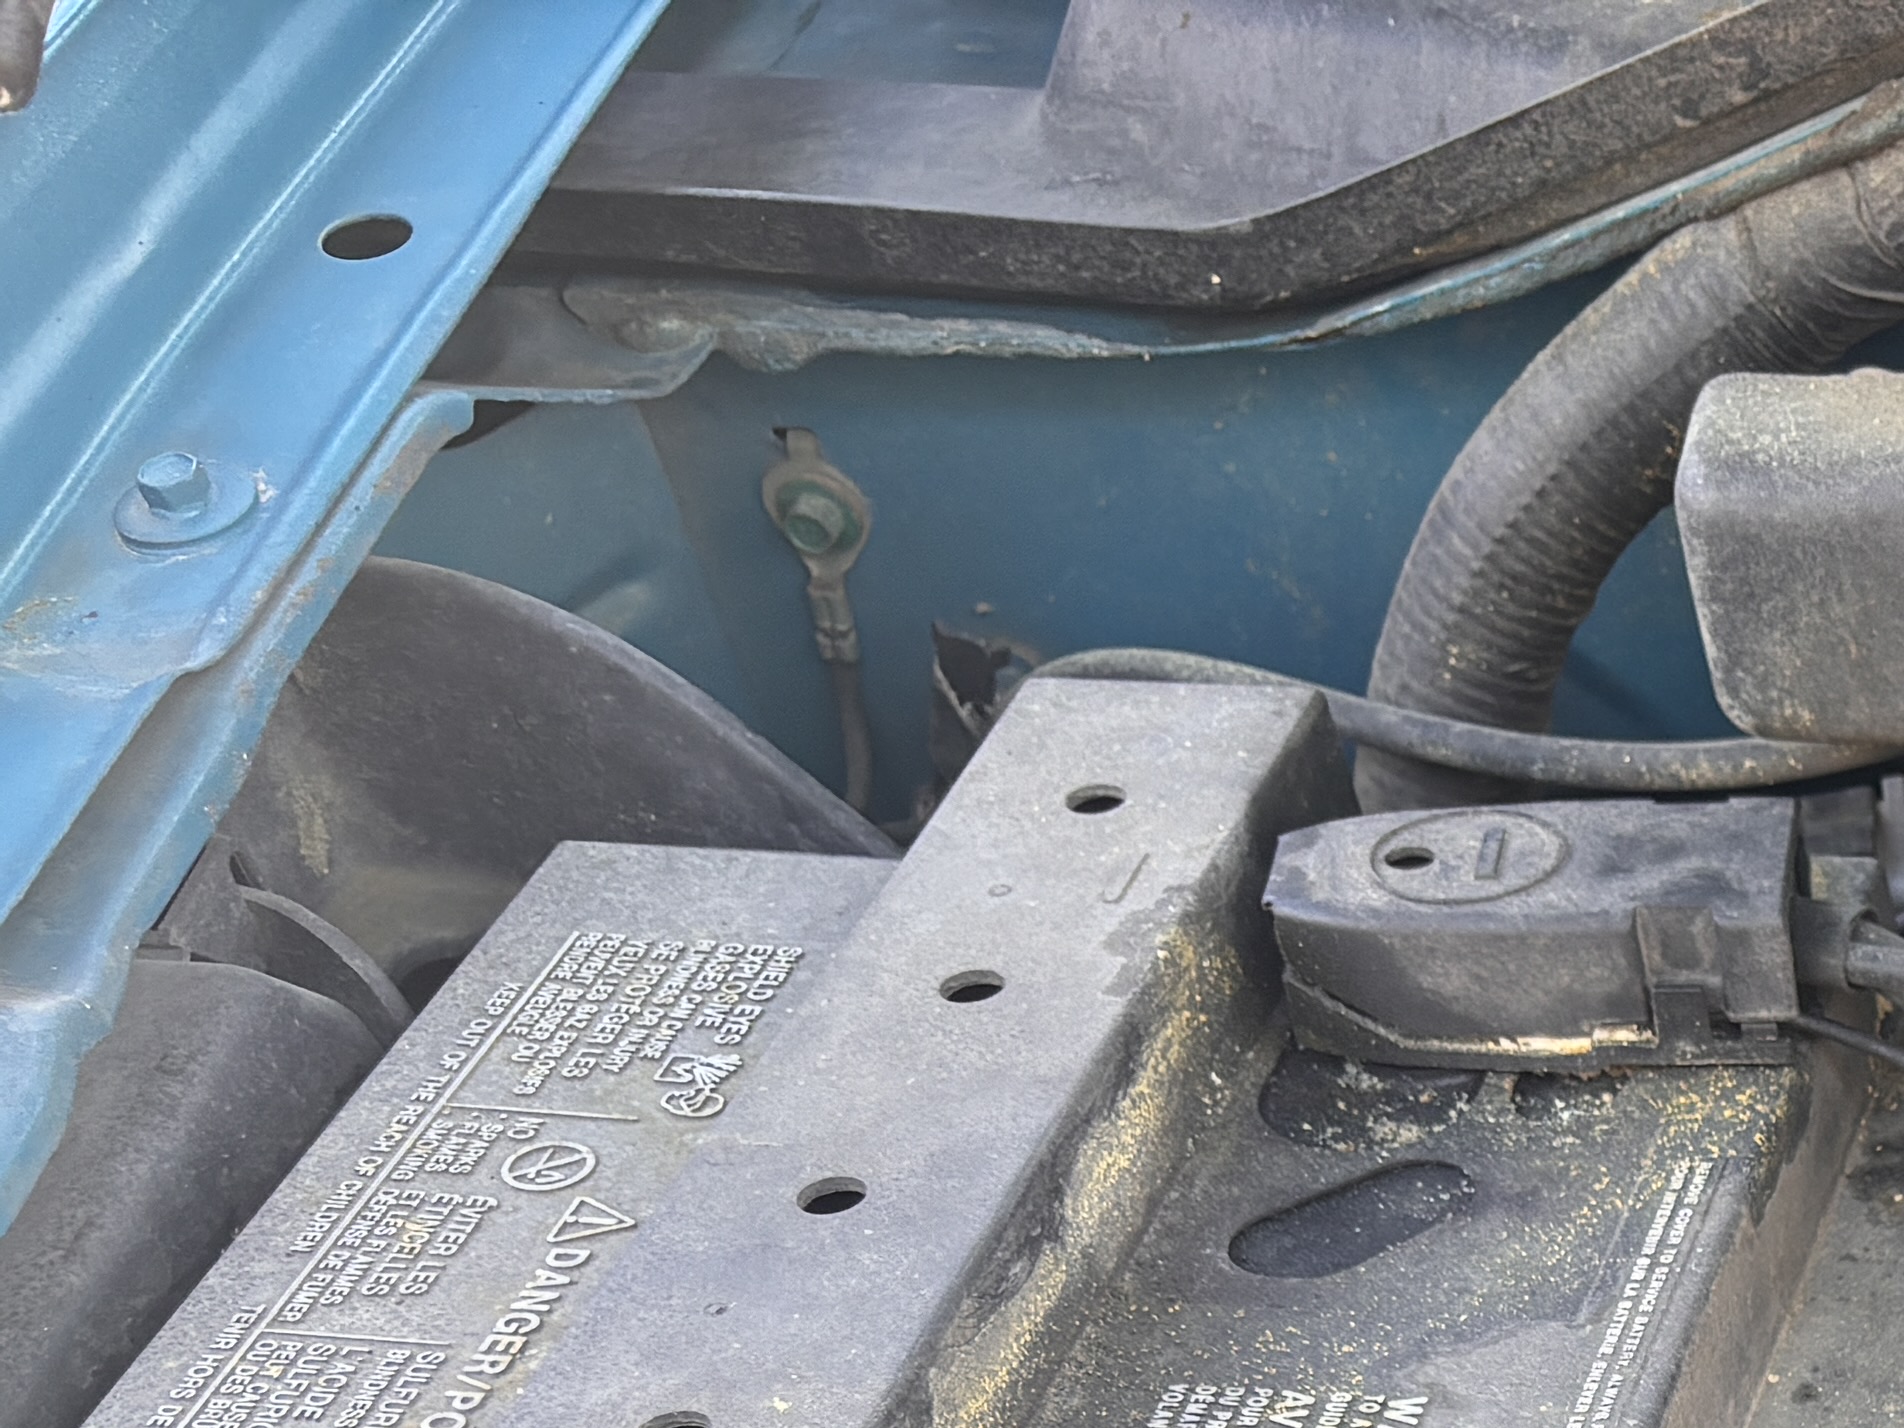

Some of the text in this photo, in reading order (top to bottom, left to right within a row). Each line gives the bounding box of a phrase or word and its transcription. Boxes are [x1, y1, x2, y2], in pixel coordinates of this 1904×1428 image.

[690, 943, 777, 1029] EXPLOSIVE
[709, 945, 806, 1045] SHIELD EYES
[558, 962, 673, 1078] PROTÉGER LES
[285, 981, 525, 1252] KEEP OUT OF THE REACH OF CHILDREN
[356, 1191, 467, 1296] ÉTINCELLES
[393, 1194, 502, 1295] ÉVITER LES
[1636, 1266, 1671, 1312] SERVICE
[206, 1303, 267, 1349] TENIR
[242, 1340, 281, 1360] OU
[254, 1341, 304, 1377] PEUT
[165, 1354, 226, 1398] HORS
[216, 1366, 260, 1393] DES
[330, 1349, 412, 1428] BLINDNESS
[1215, 1385, 1247, 1406] DU
[143, 1405, 185, 1426] DE
[1356, 1393, 1386, 1413] TO
